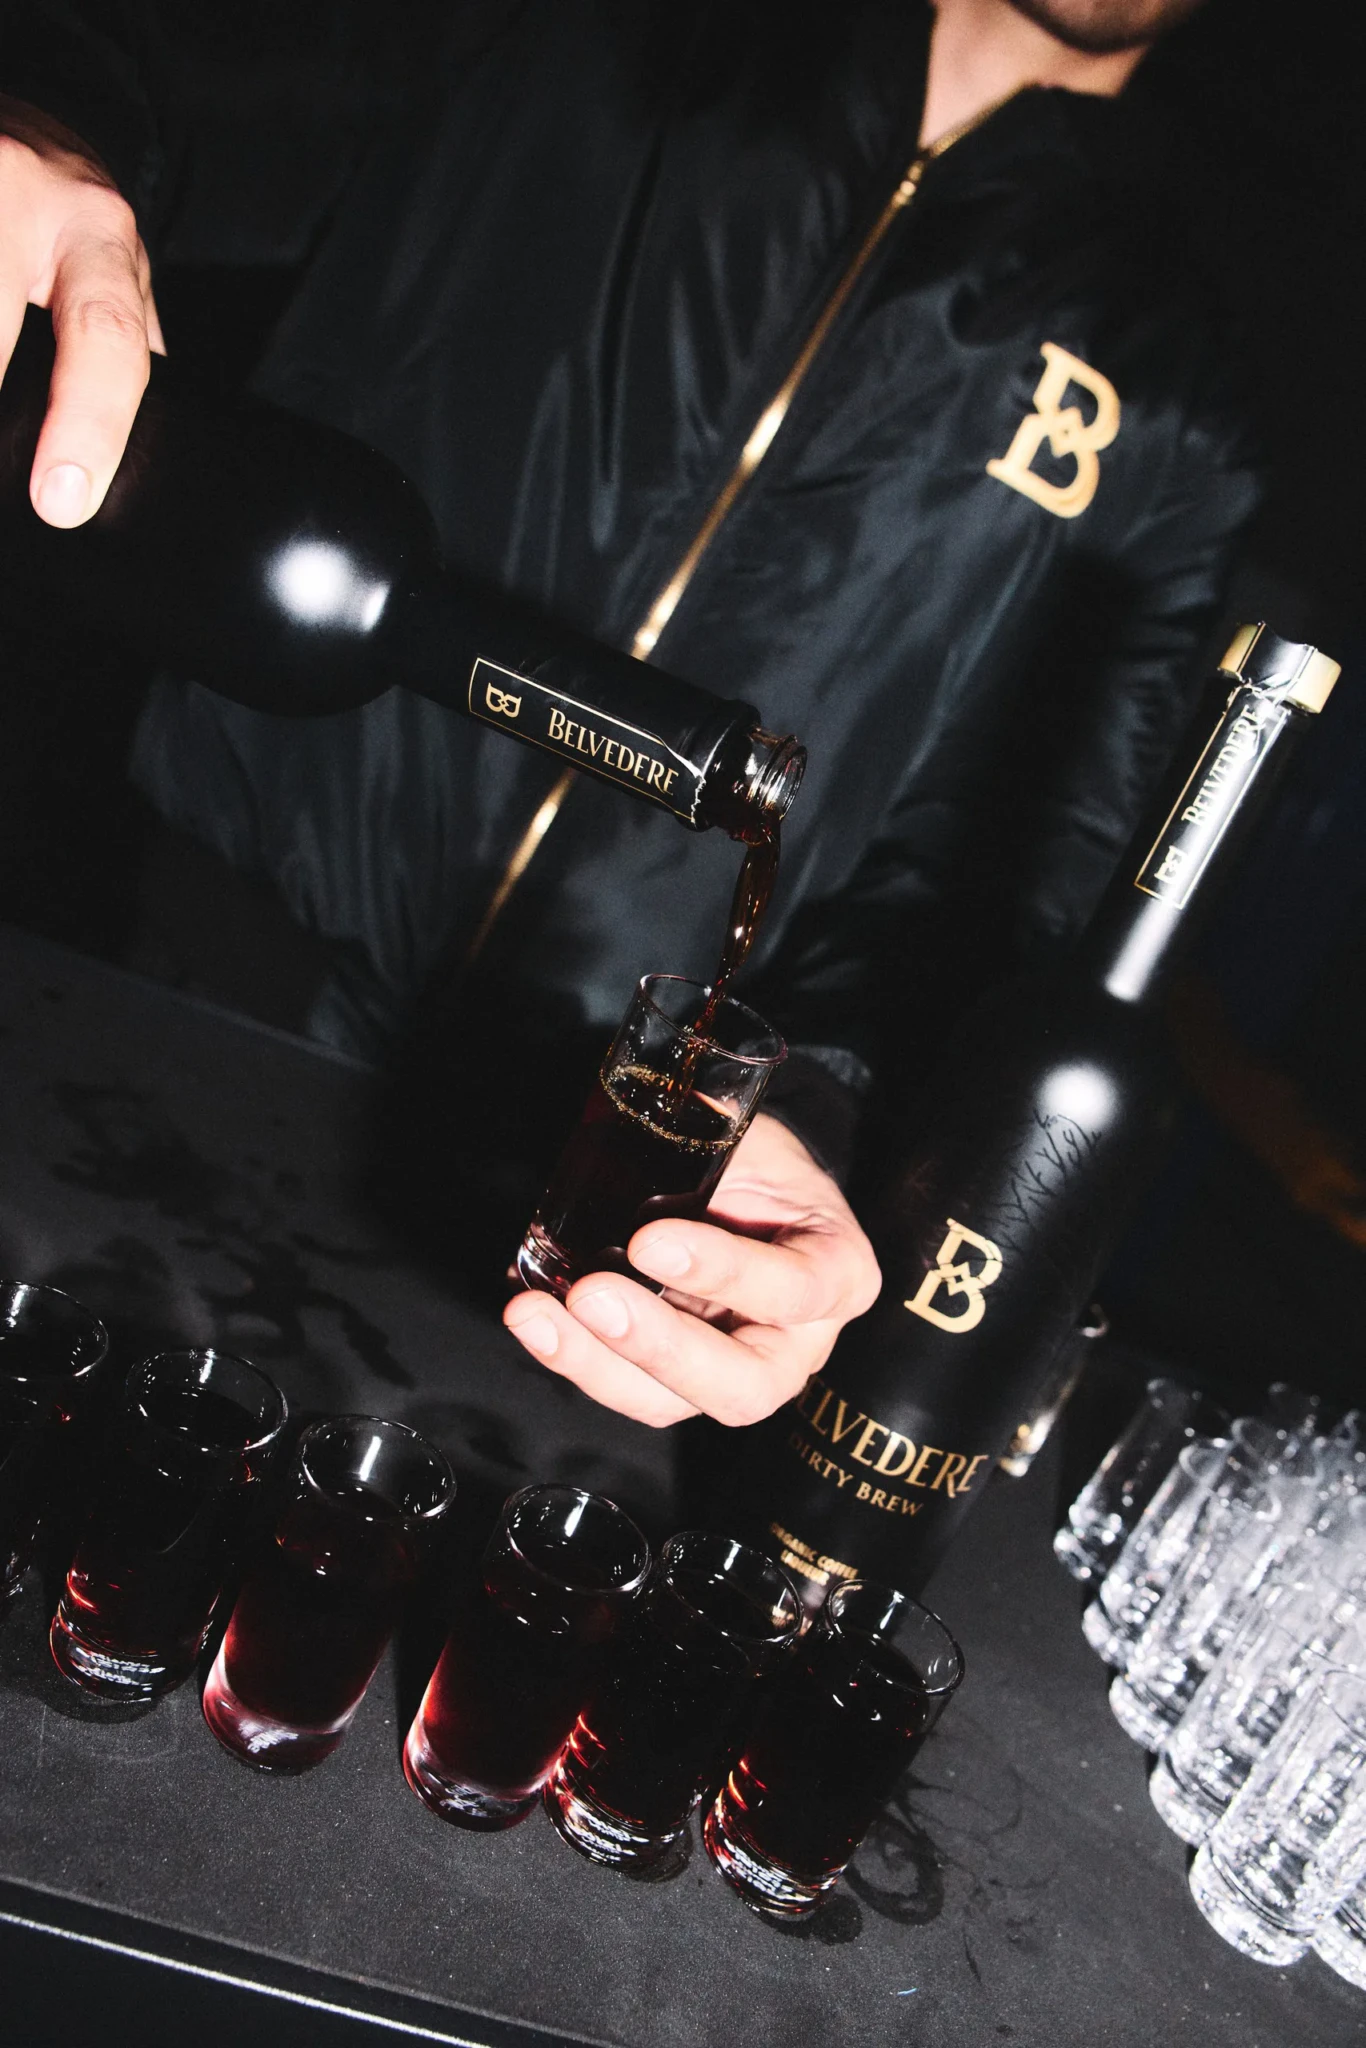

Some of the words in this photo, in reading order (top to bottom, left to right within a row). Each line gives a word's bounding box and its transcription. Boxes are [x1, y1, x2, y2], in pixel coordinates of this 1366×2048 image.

[547, 707, 680, 796] BELVEDERE
[1181, 704, 1266, 827] BELVEDERE
[789, 1431, 855, 1489] DIRTY
[855, 1481, 924, 1517] BREW
[796, 1374, 989, 1499] ELVEDERE
